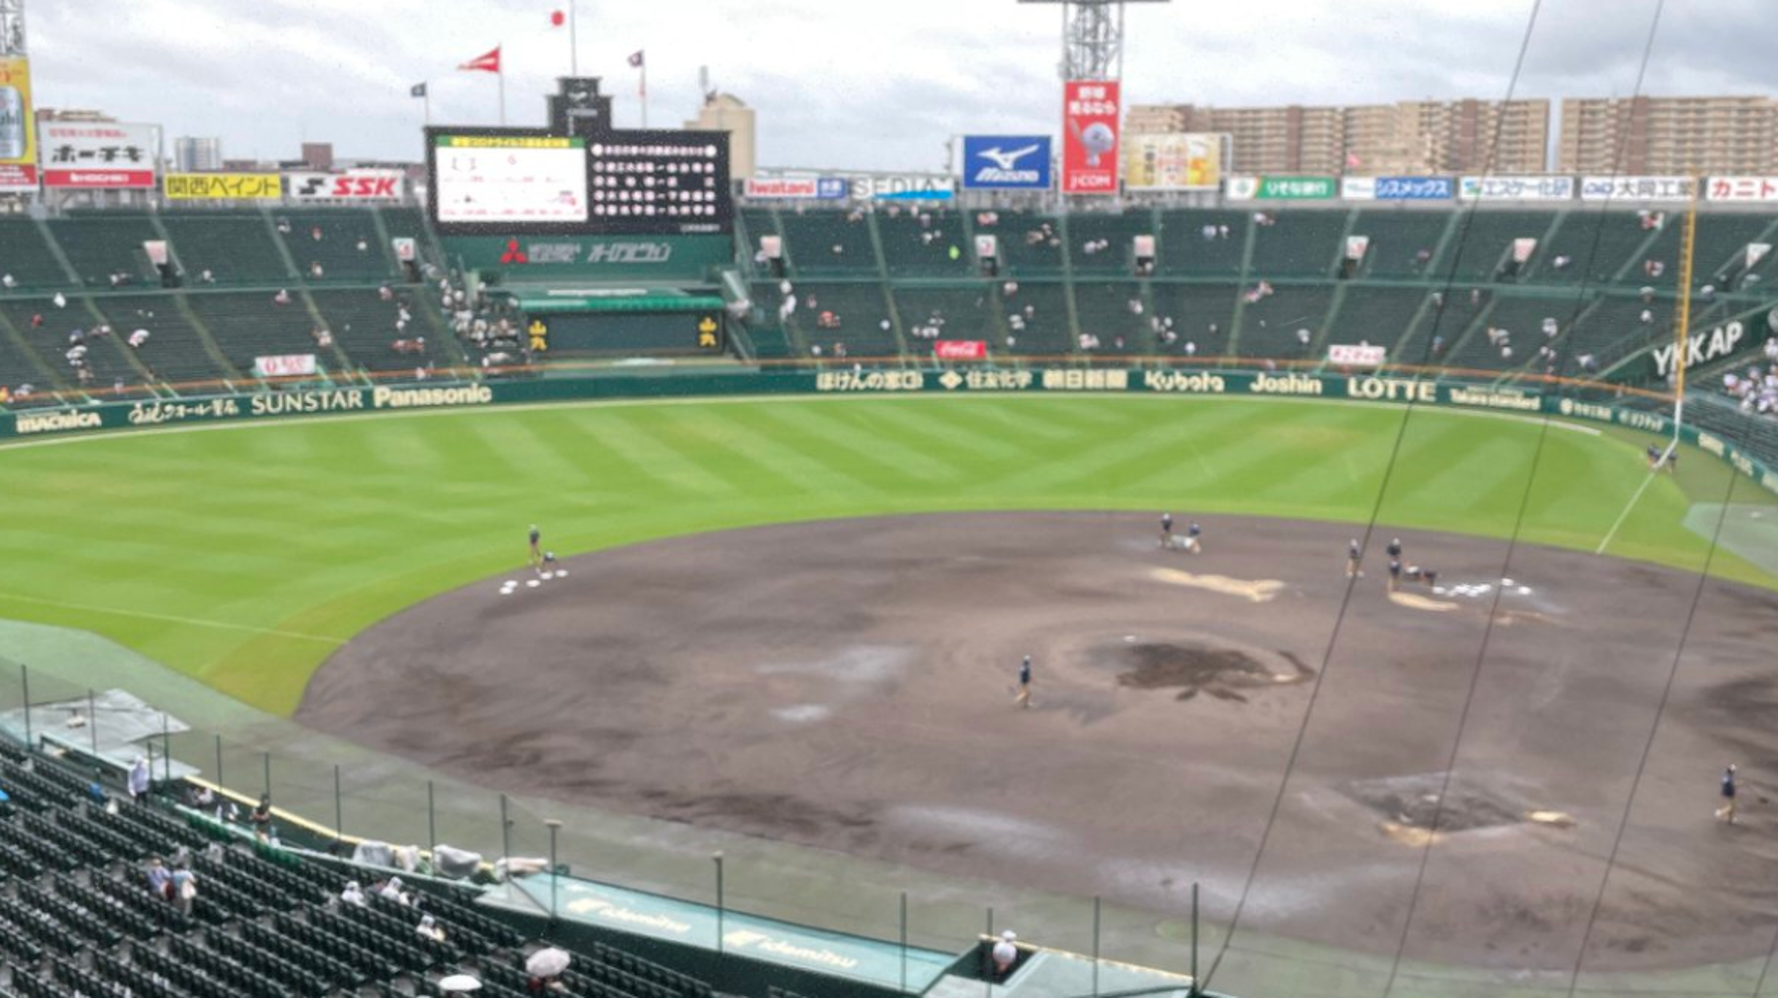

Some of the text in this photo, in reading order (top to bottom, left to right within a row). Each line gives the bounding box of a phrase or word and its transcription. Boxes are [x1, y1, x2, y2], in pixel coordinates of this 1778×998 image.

[167, 176, 279, 196] 関西ペイント
[332, 177, 396, 196] SSK
[748, 180, 815, 195] Iwatani
[1266, 180, 1328, 196] りそな銀行
[1376, 179, 1449, 197] シスメックス
[1653, 321, 1743, 376] YKK AP
[1145, 371, 1225, 392] Kubota
[1250, 373, 1322, 395] Joshin
[1348, 377, 1436, 401] LOTTE
[251, 389, 363, 415] SUNSTAR
[374, 384, 492, 407] Panasonic
